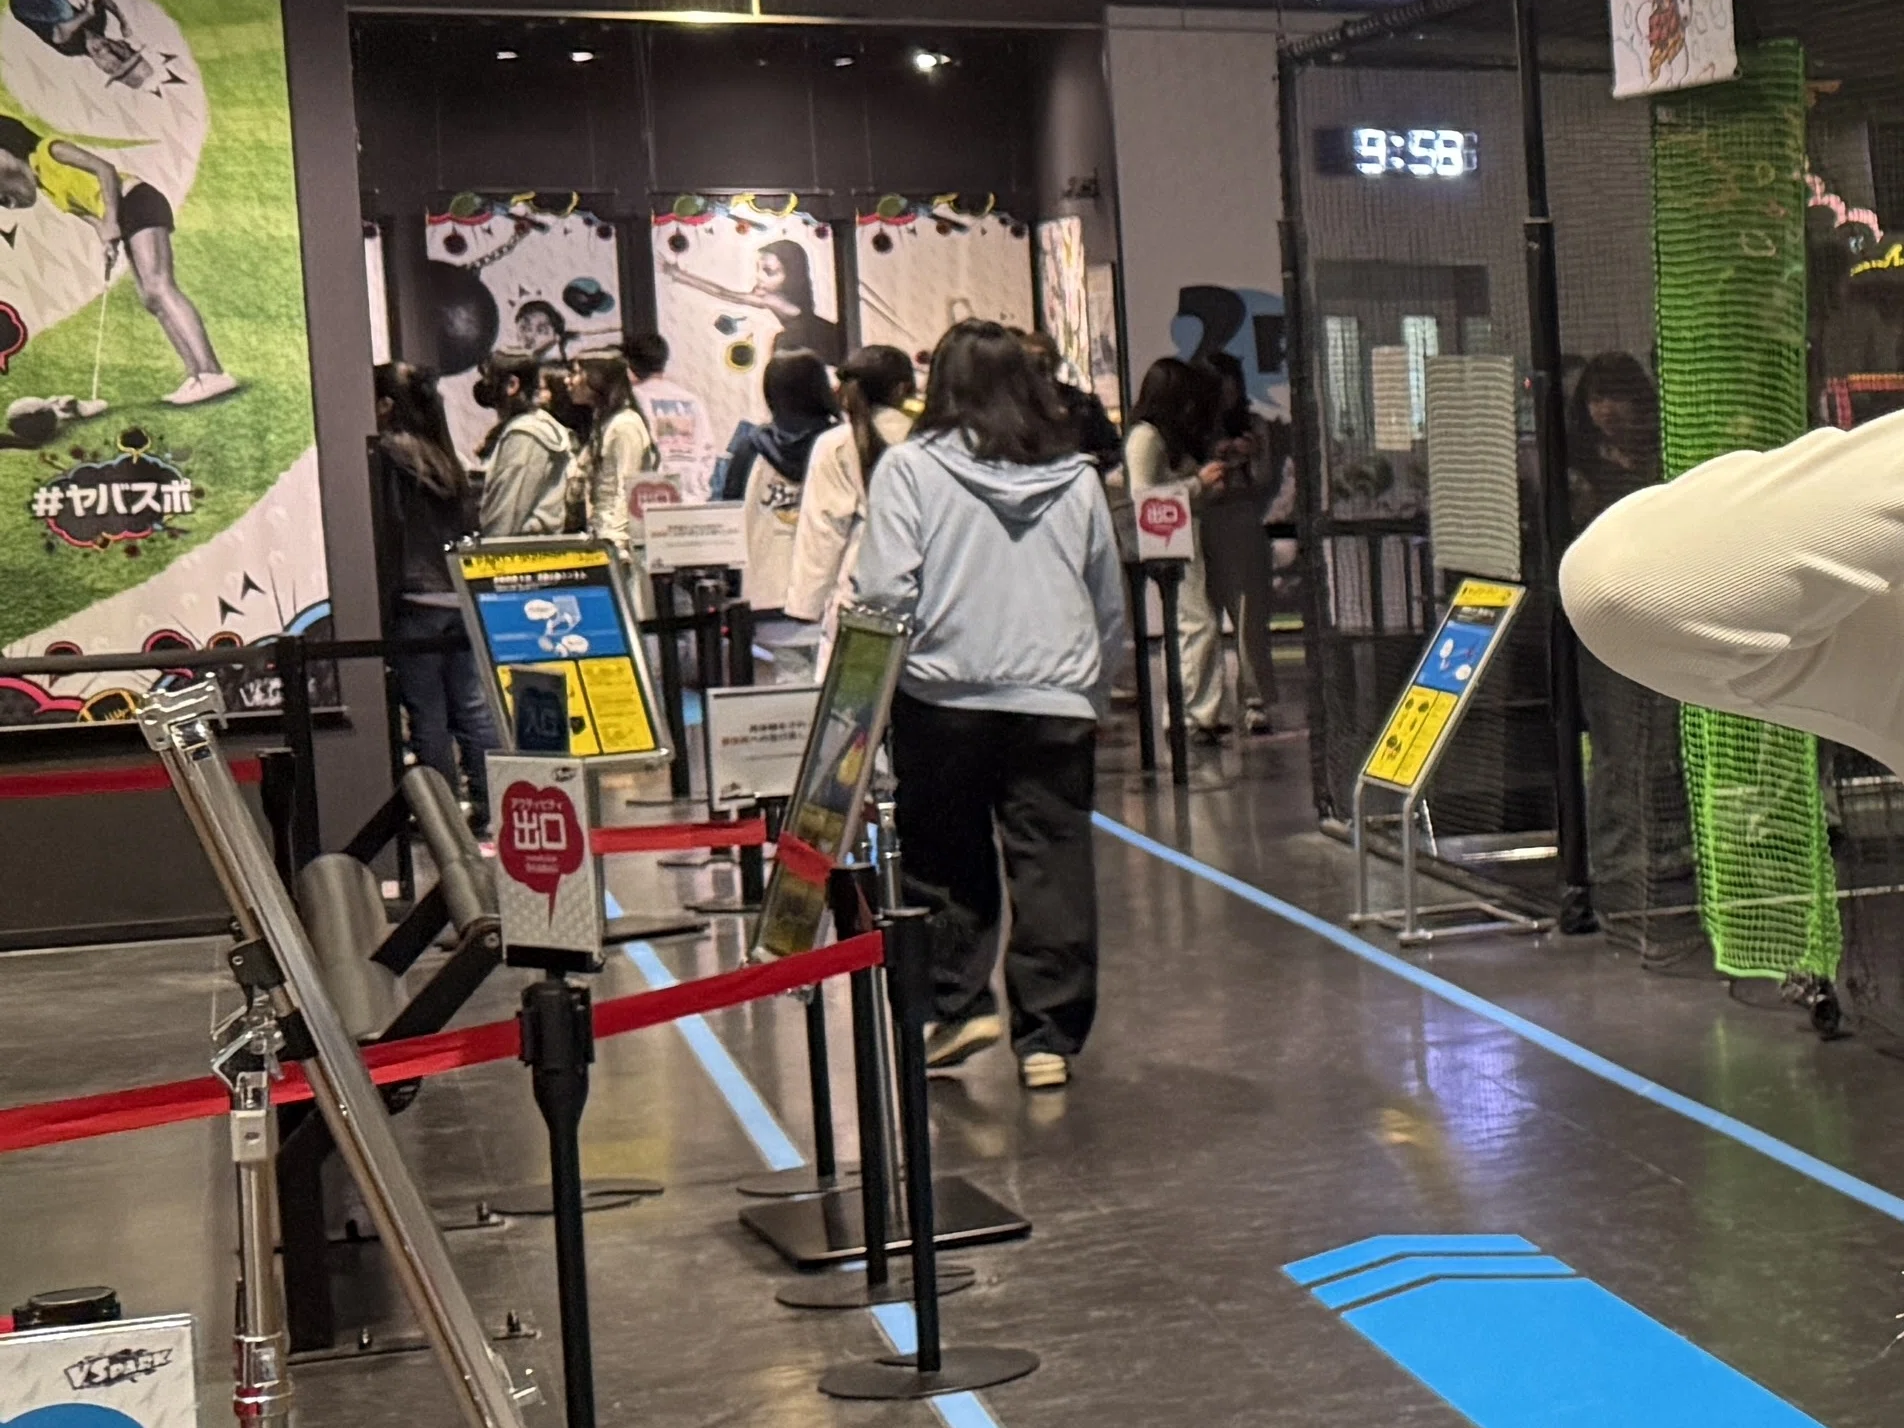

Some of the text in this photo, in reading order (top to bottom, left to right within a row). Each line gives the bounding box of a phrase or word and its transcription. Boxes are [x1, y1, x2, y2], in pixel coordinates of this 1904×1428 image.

[32, 478, 193, 518] #ヤバスポ
[513, 810, 568, 851] 出口
